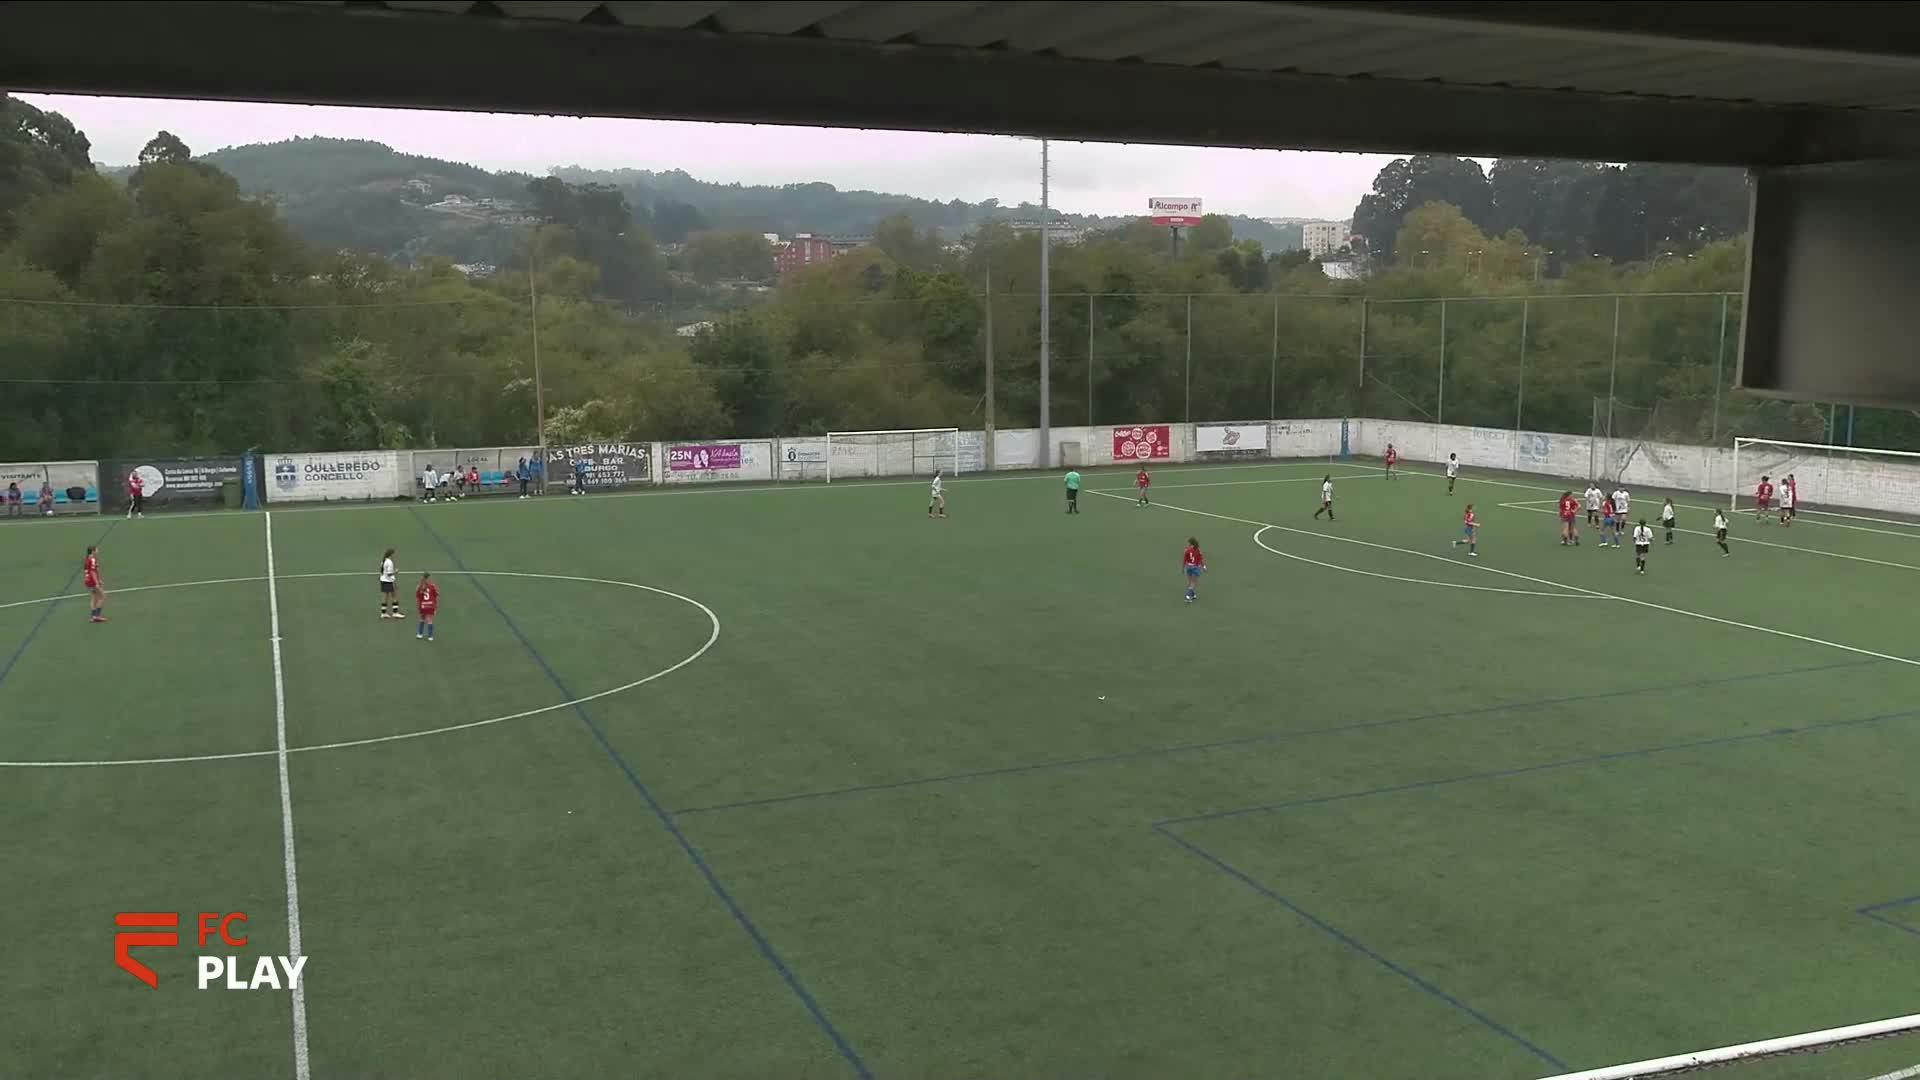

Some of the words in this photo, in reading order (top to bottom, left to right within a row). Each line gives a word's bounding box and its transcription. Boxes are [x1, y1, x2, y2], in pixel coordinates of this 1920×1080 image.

[549, 450, 564, 462] AS
[671, 450, 692, 461] 25N
[603, 457, 624, 465] BAR
[305, 473, 363, 481] CONCELLO
